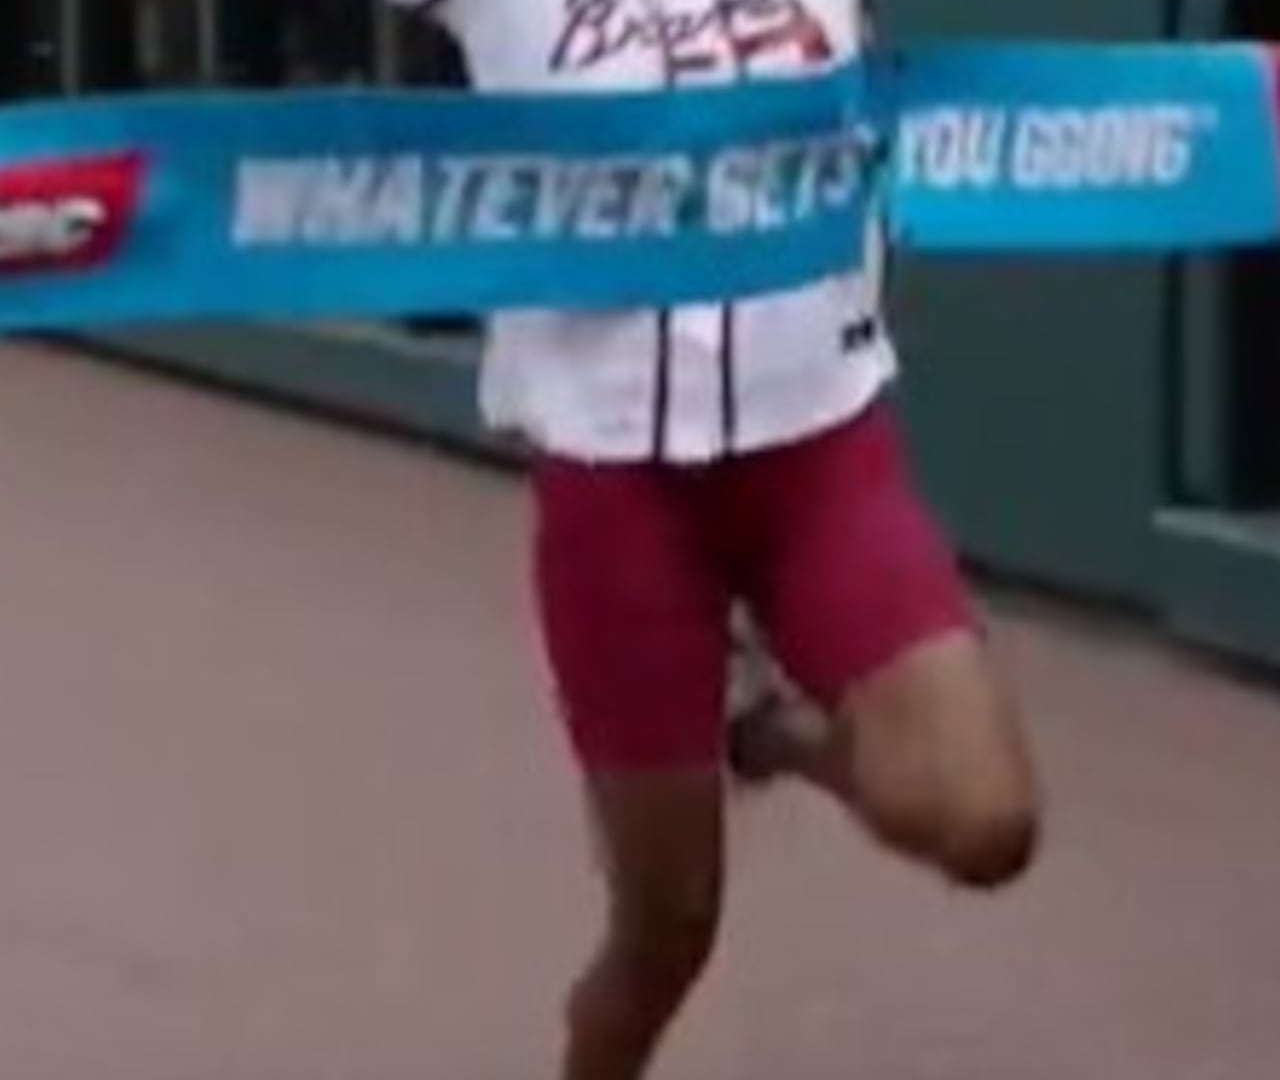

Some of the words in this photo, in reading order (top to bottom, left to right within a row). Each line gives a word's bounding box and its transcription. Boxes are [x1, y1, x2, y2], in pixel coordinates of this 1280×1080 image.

[232, 146, 696, 246] WHATEVER
[706, 120, 874, 234] GETS
[894, 102, 1006, 190] YOU
